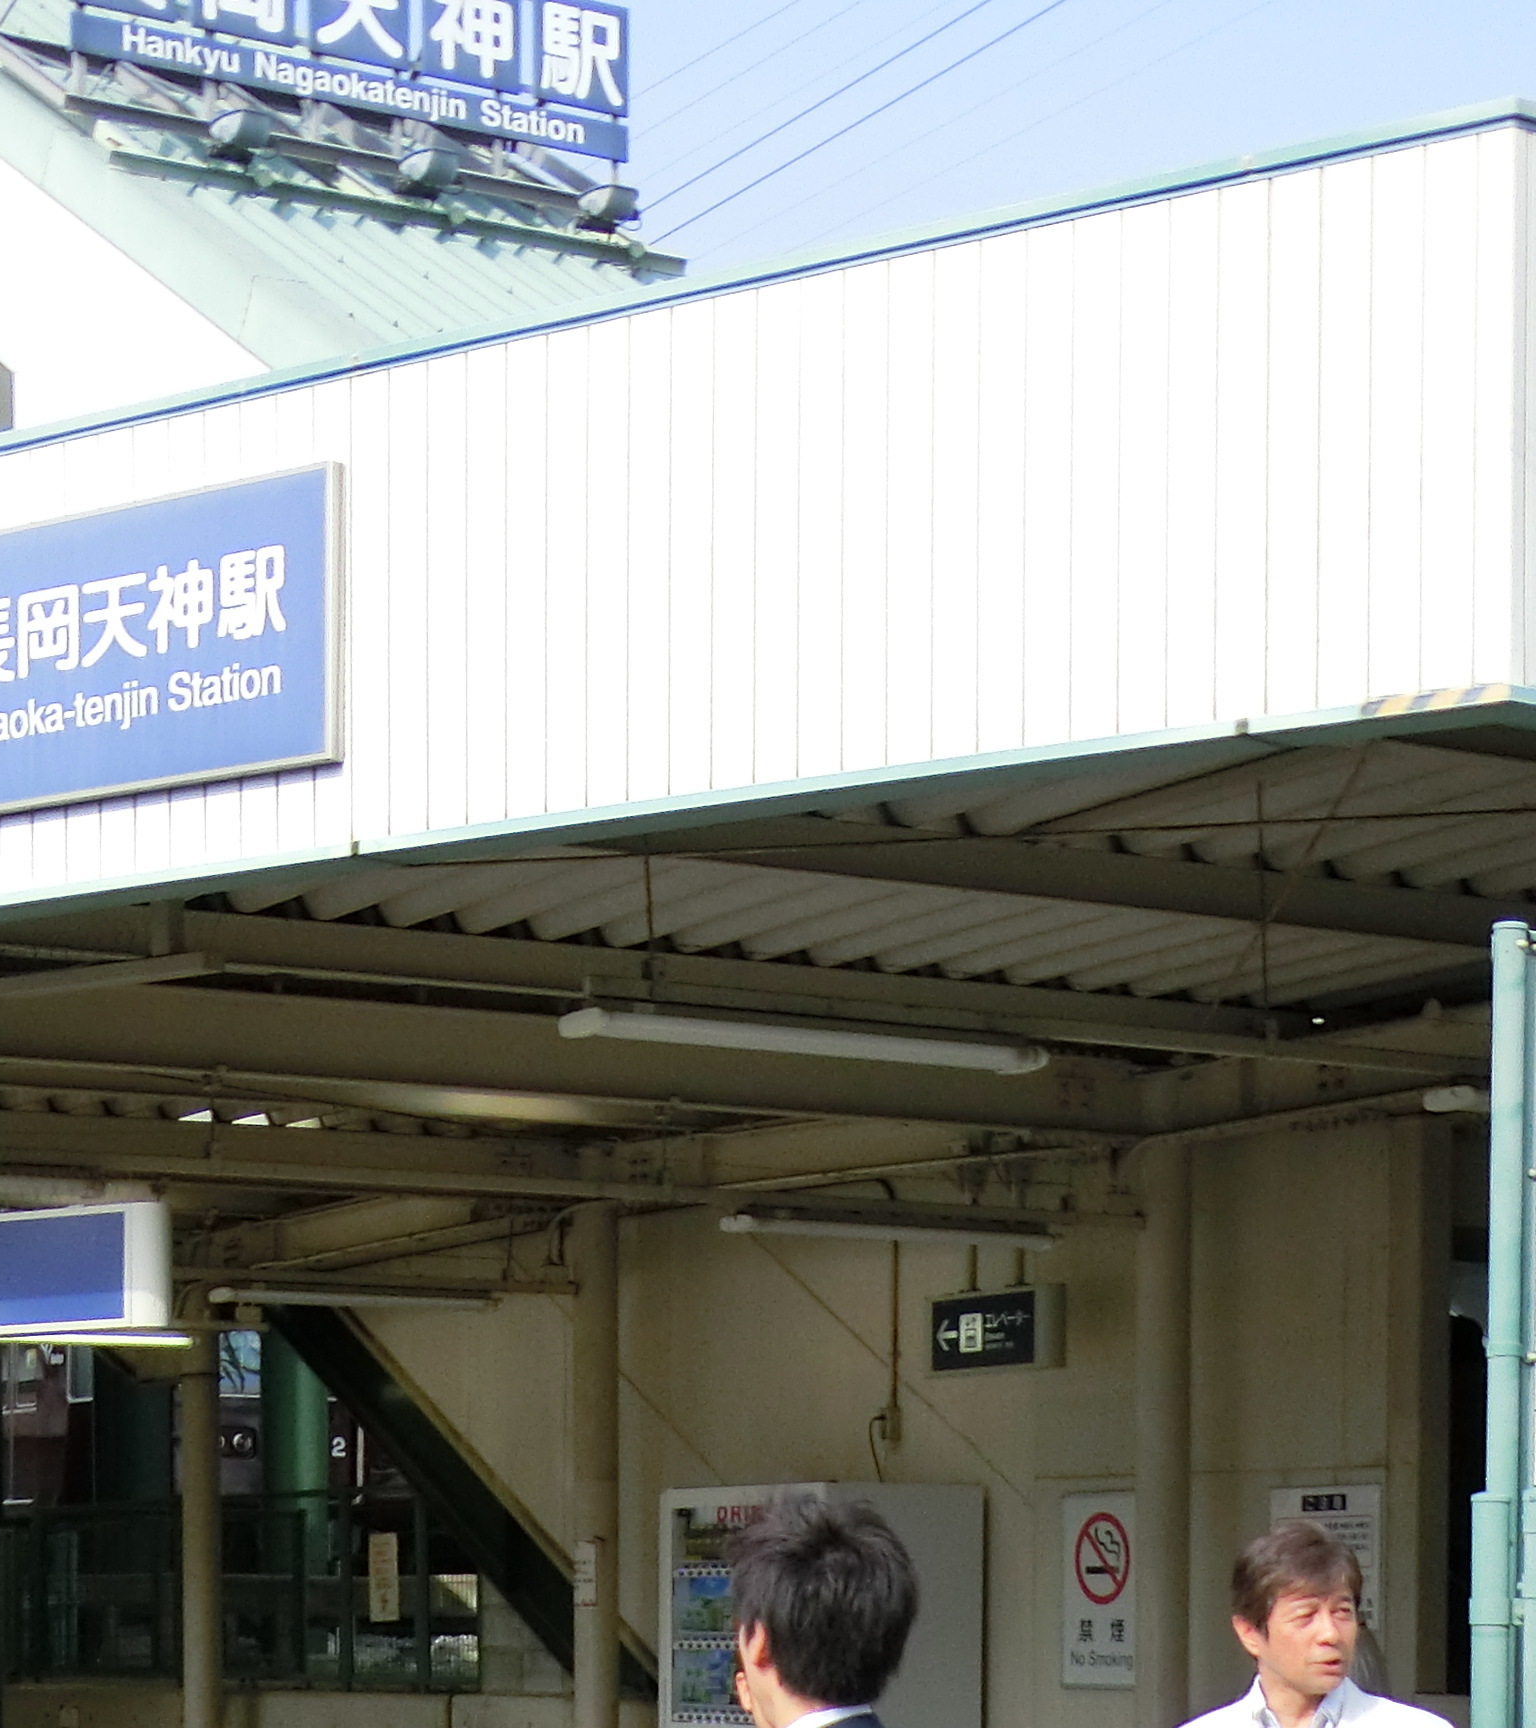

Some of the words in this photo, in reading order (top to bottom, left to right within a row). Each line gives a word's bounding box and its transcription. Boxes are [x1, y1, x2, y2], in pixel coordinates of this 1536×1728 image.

[121, 23, 241, 75] Hankyu
[254, 50, 466, 122] Nagaokatenjin
[480, 101, 586, 145] Station
[167, 663, 282, 713] Station
[1070, 1651, 1085, 1666] No
[1088, 1649, 1134, 1671] Smoking
